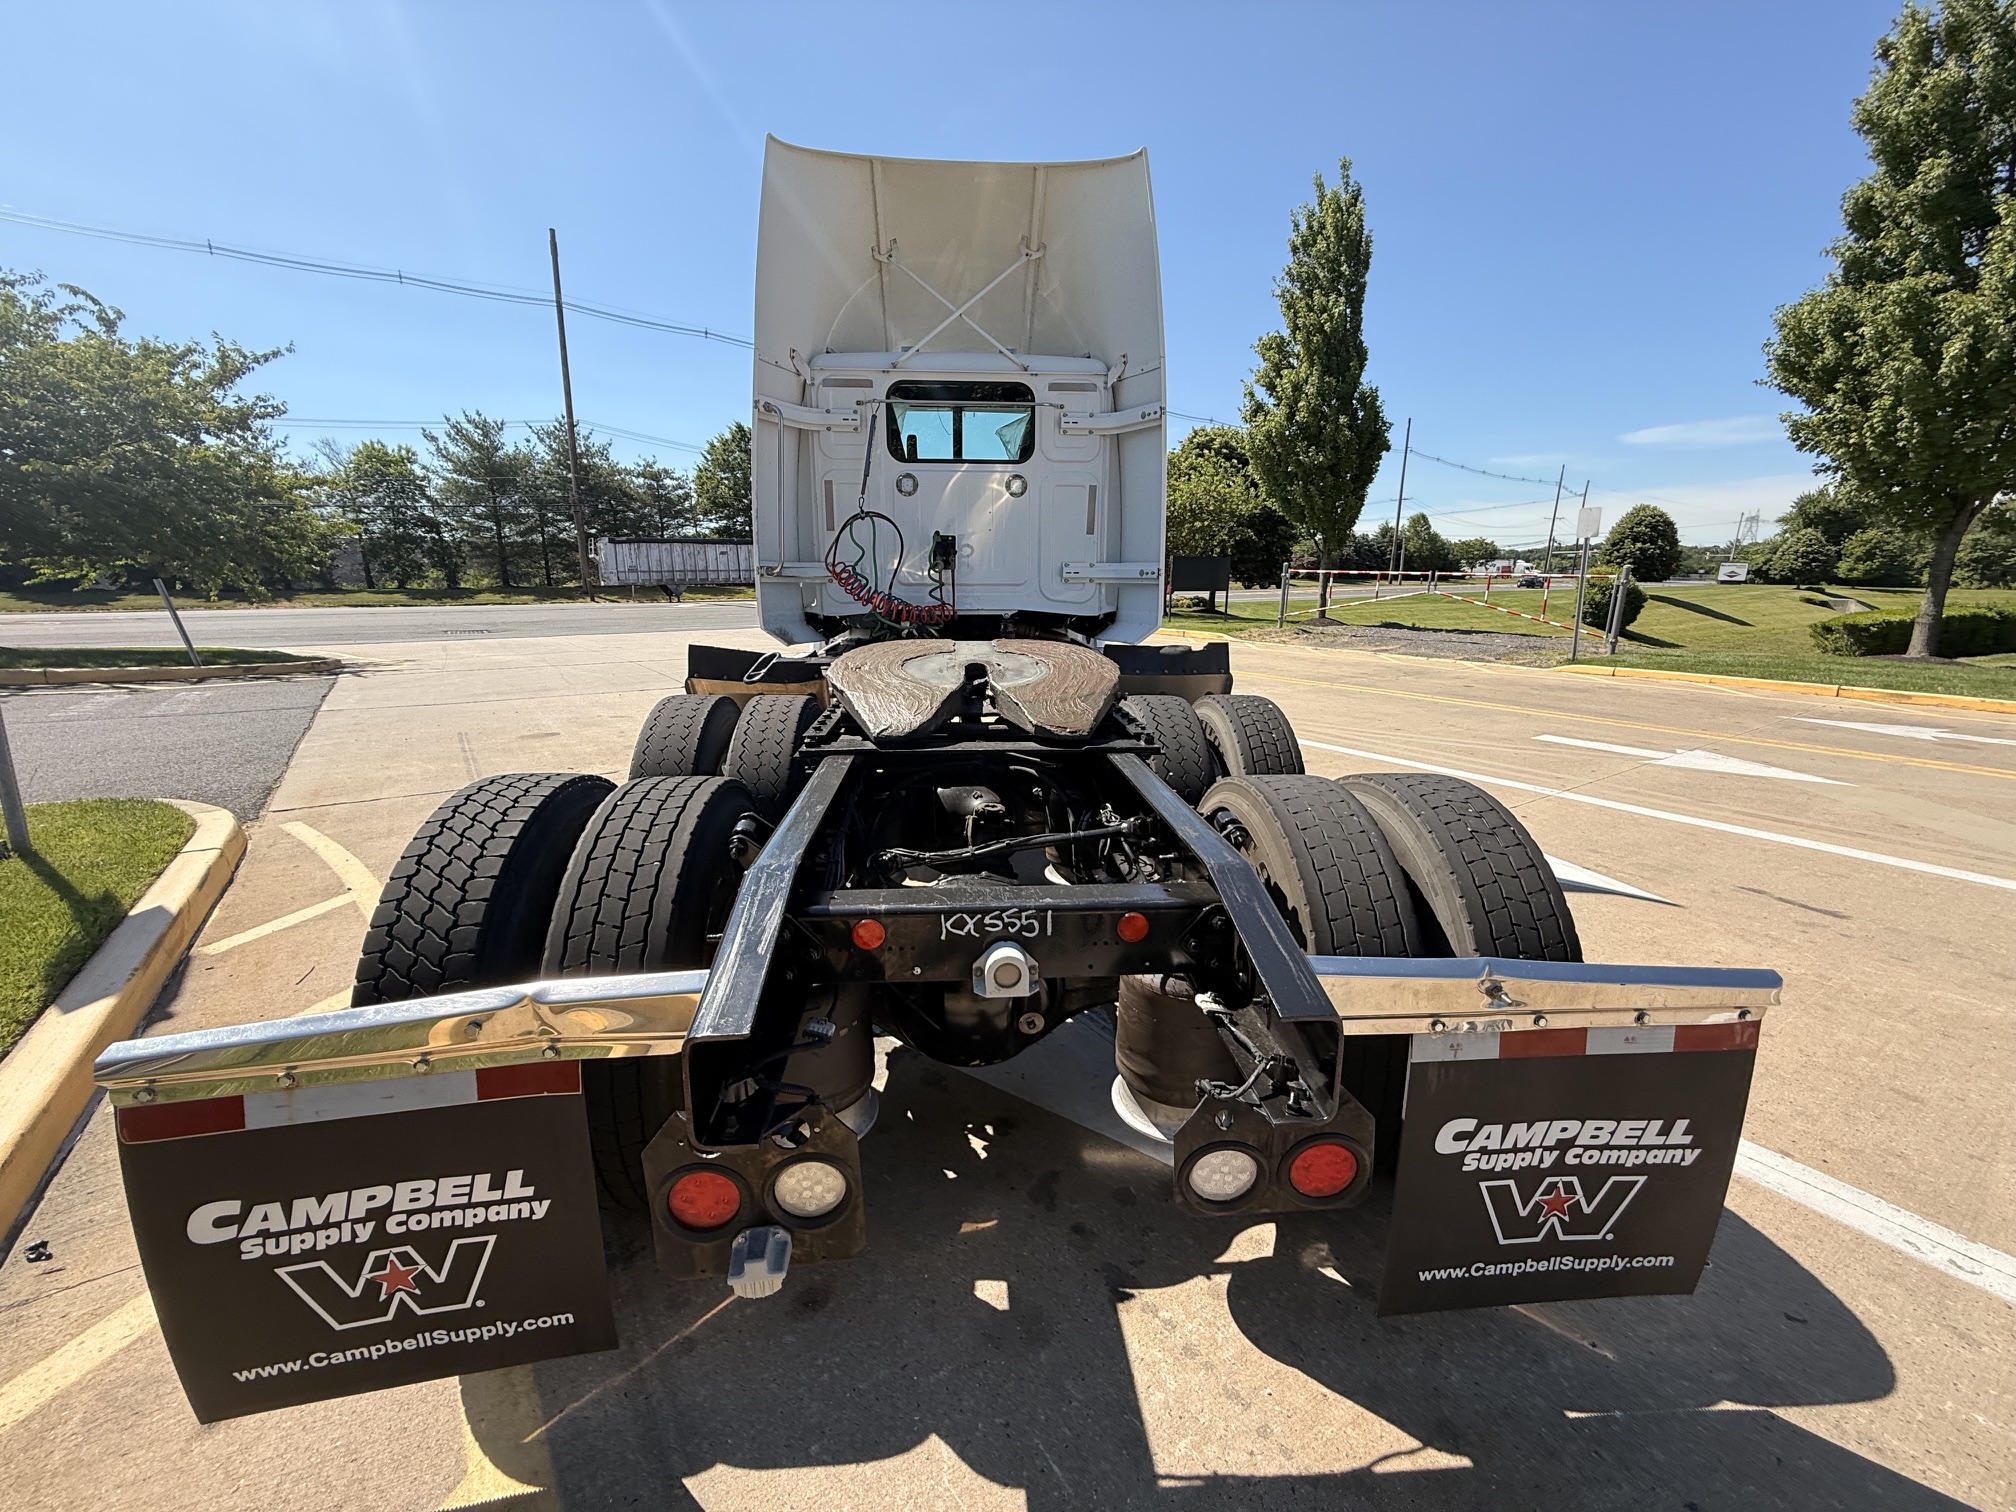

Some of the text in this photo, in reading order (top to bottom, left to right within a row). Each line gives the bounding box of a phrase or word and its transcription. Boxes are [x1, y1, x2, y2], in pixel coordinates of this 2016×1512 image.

[940, 908, 1053, 940] KX5551
[1434, 1118, 1695, 1155] CAMPBELL
[1461, 1146, 1702, 1172] Supply Company
[185, 1169, 535, 1245] CAMPBELL
[239, 1198, 552, 1261] Supply Company
[1418, 1253, 1676, 1283] www.CampbellSupply.com
[231, 1310, 576, 1384] www.CampbellSupply.com
